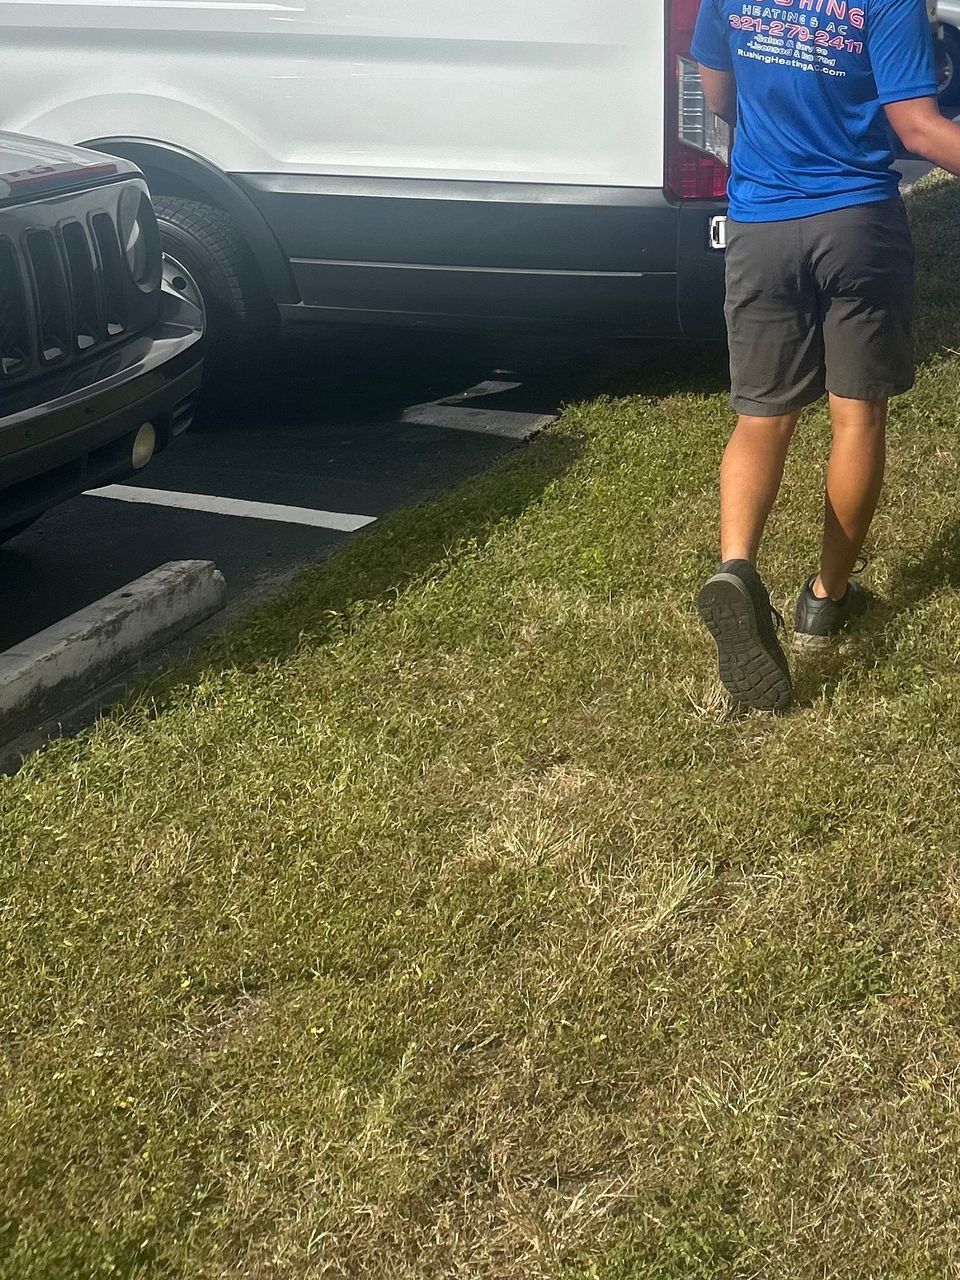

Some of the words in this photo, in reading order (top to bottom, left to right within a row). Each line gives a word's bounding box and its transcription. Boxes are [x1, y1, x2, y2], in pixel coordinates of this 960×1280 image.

[729, 14, 863, 54] 321-279-2411
[742, 4, 806, 24] HEATING
[809, 17, 819, 27] &
[826, 21, 848, 35] AC
[785, 39, 795, 48] &
[737, 48, 846, 77] RushingHeatingAC.com
